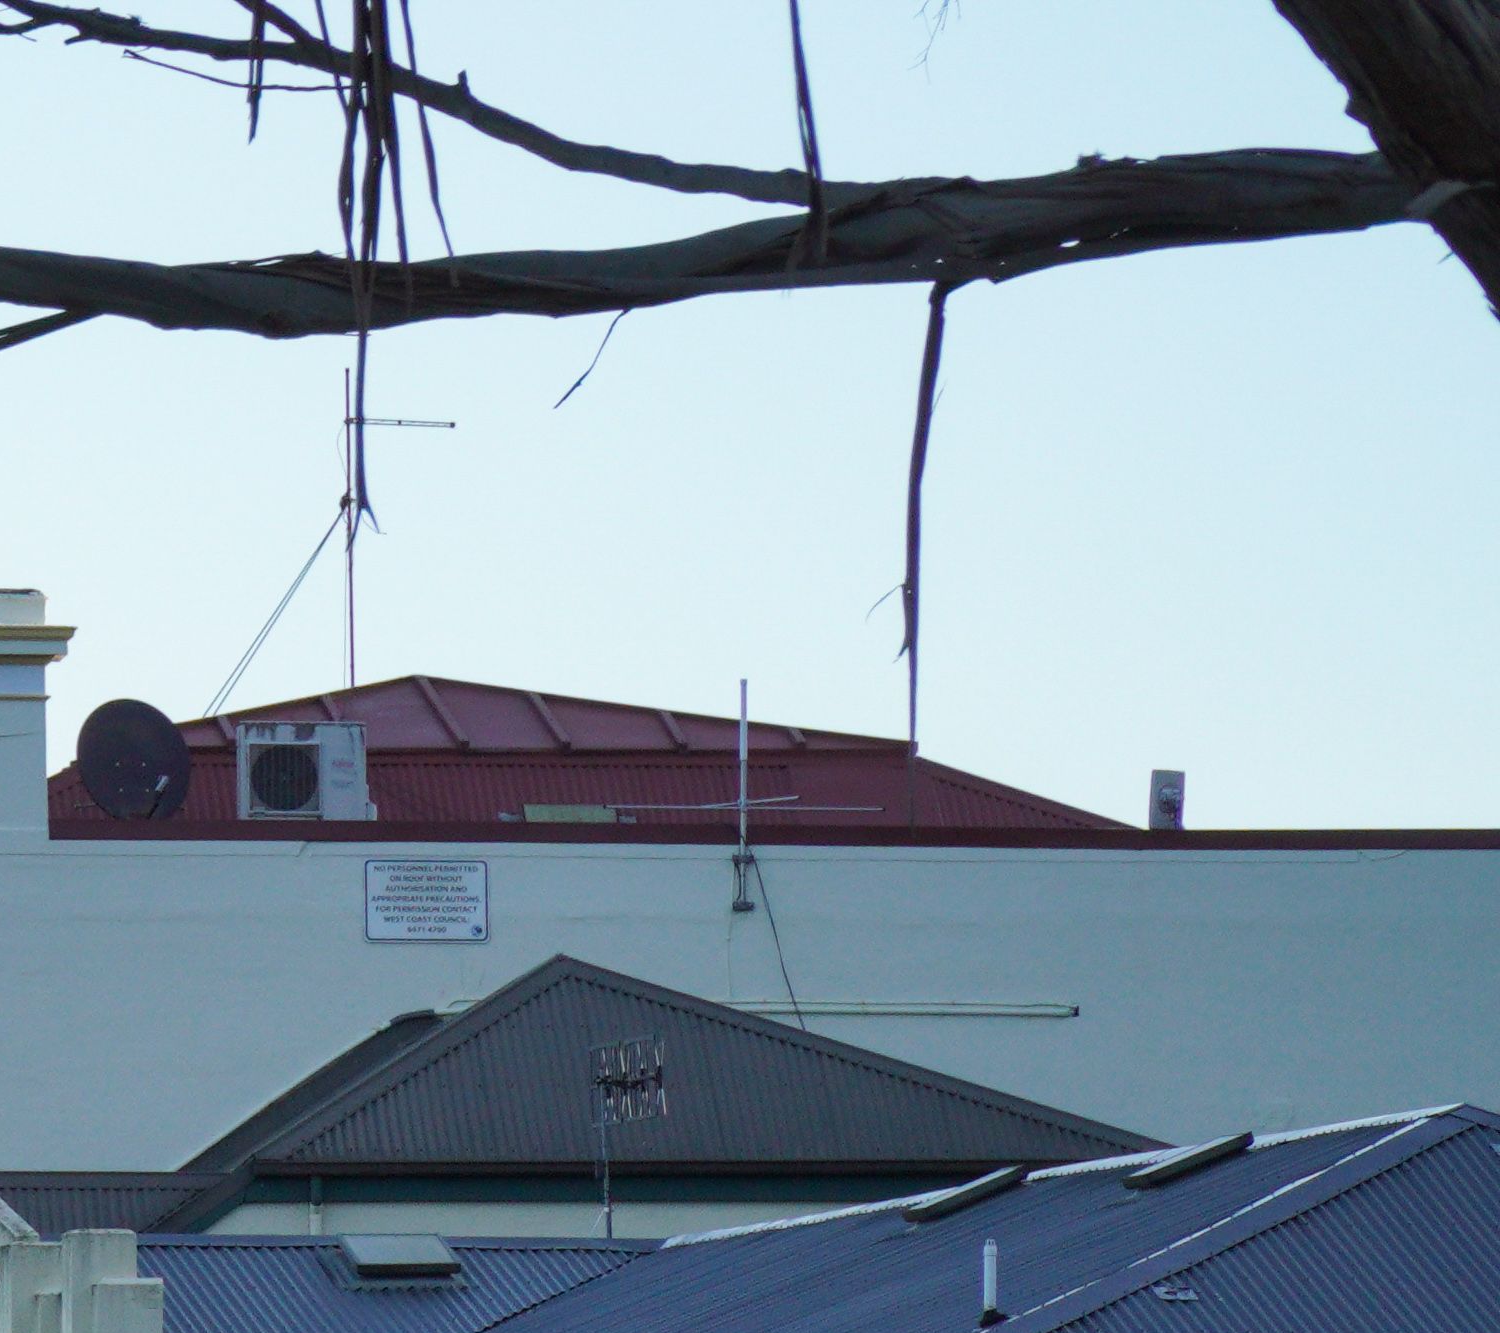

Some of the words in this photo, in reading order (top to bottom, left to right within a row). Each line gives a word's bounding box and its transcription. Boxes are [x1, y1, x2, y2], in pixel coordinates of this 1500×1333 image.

[372, 895, 423, 903] APPROPRIATE
[384, 915, 404, 923] WEST
[407, 915, 431, 923] COAST
